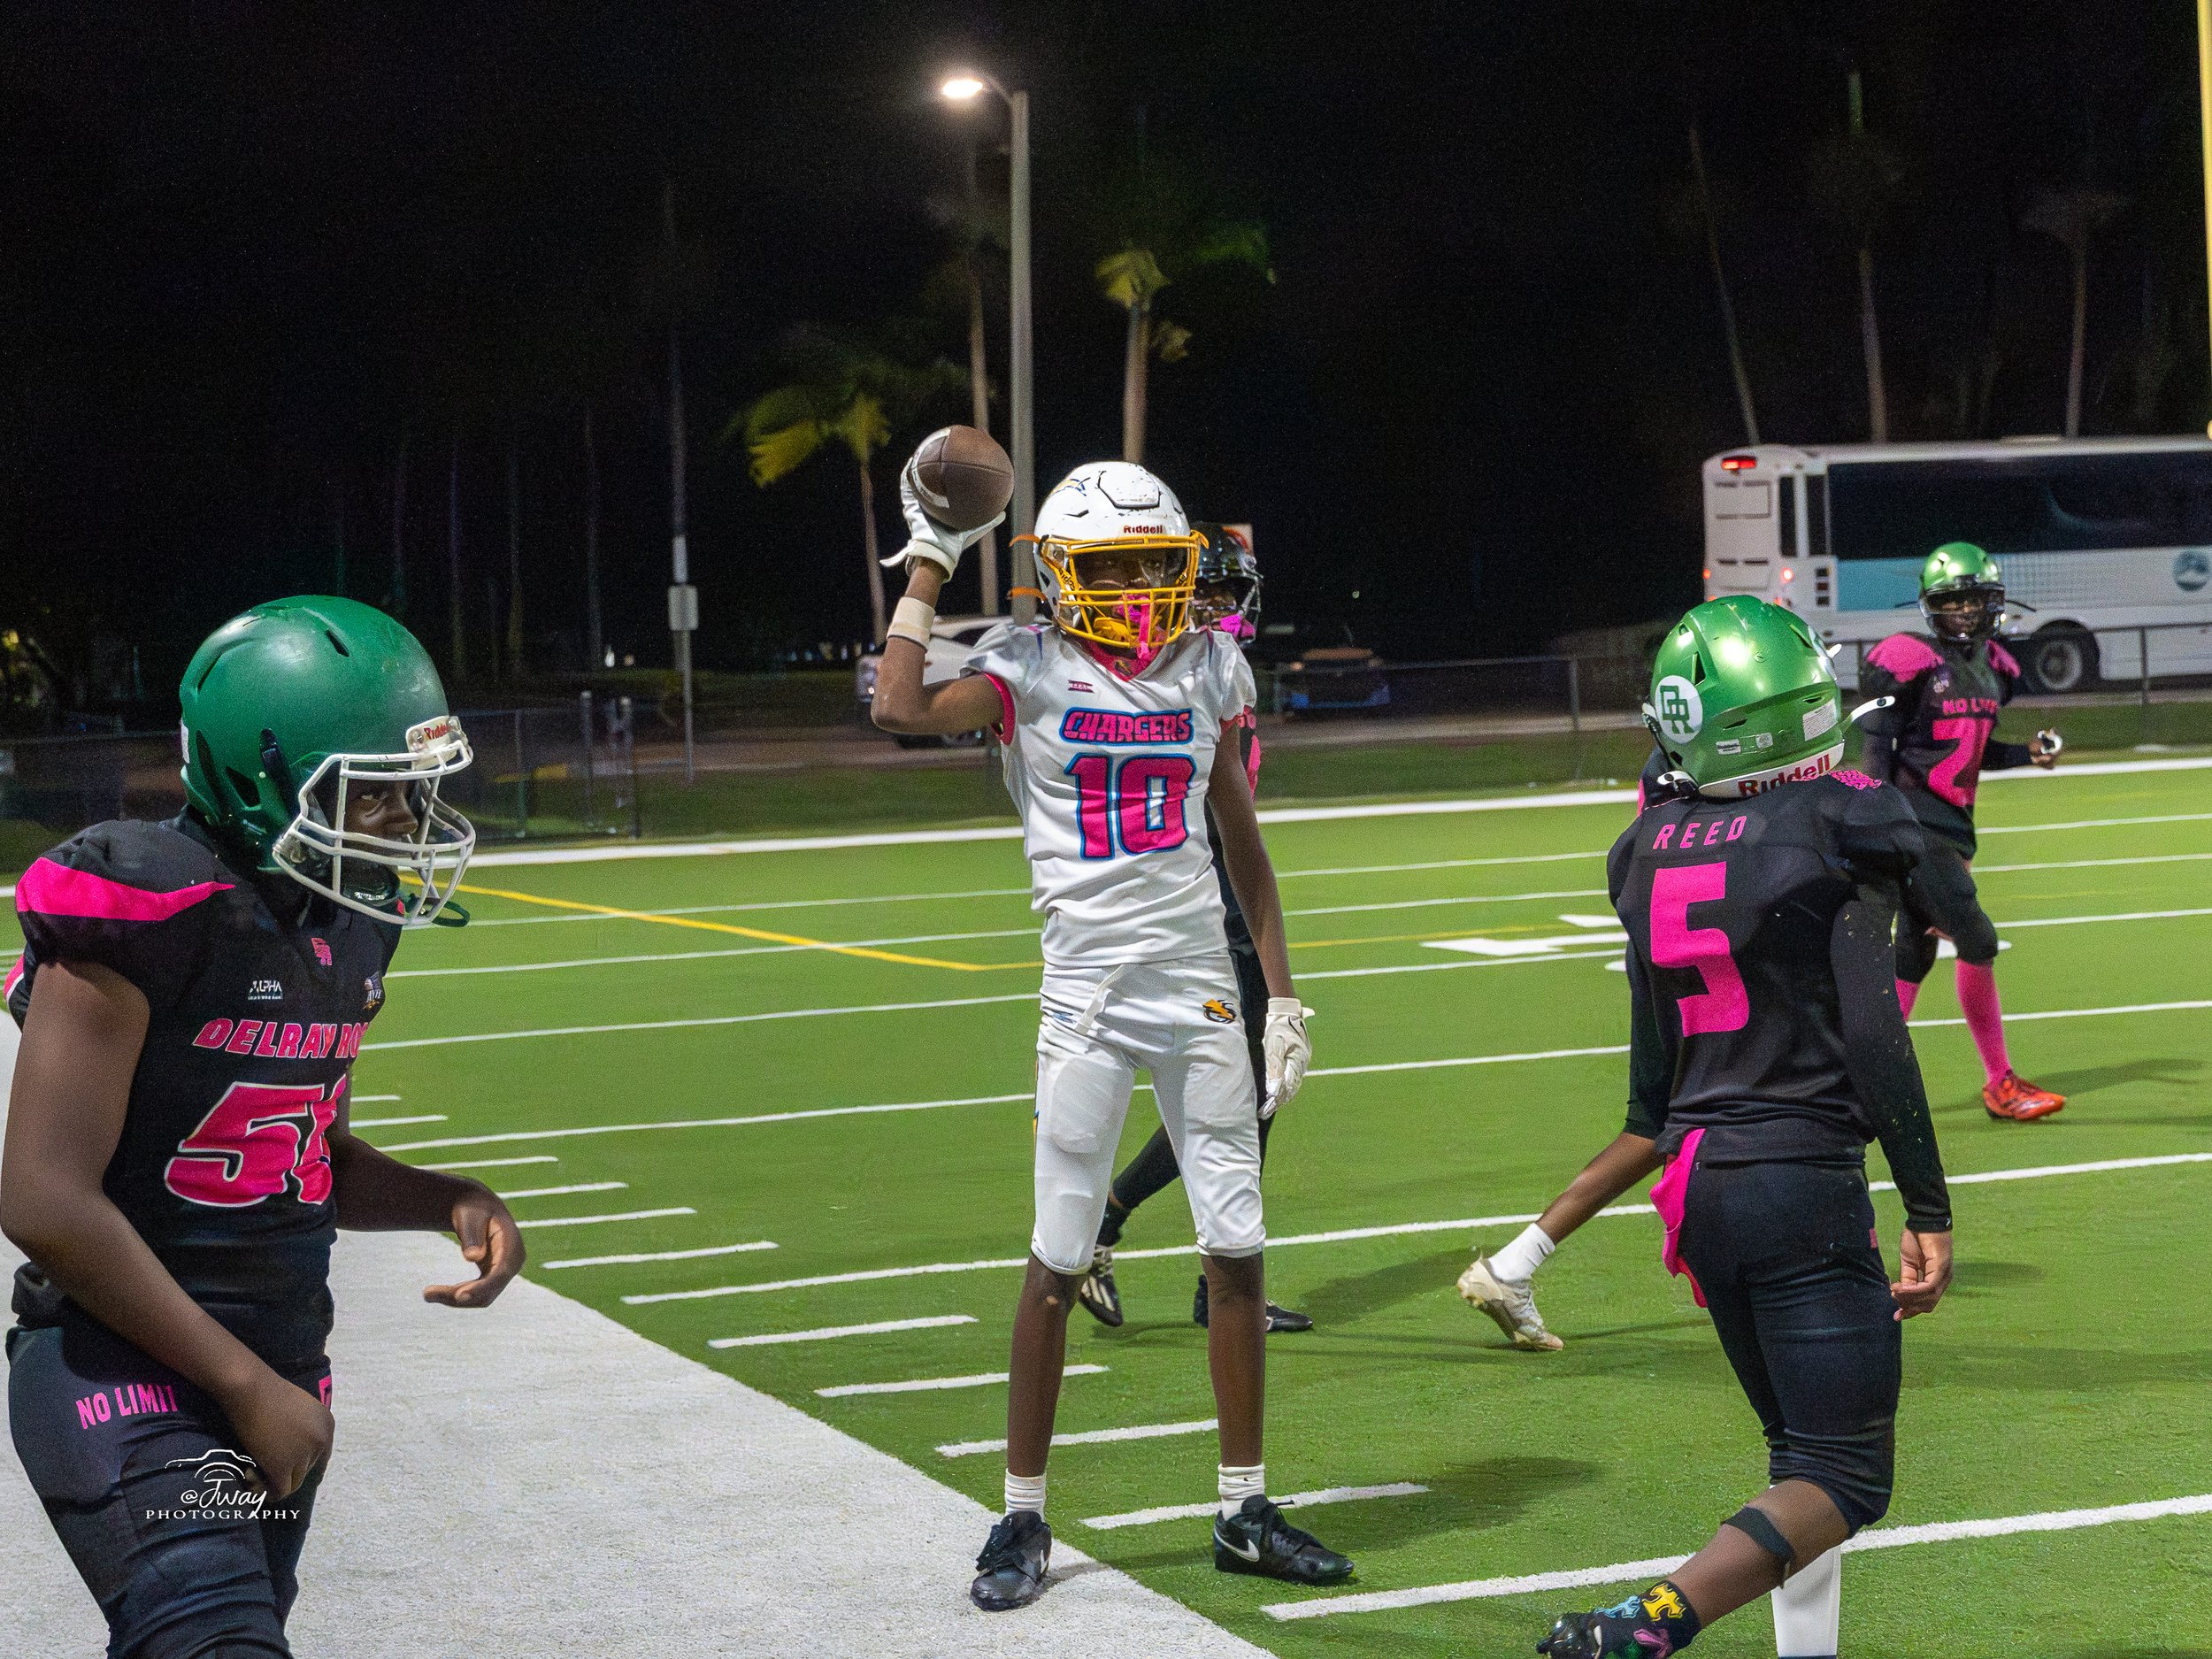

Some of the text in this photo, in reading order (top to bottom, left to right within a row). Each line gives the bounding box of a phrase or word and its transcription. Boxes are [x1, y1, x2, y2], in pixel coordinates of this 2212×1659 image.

[1123, 524, 1164, 534] Riddell
[1060, 708, 1194, 745] CHARGERS
[1064, 753, 1196, 860] 10
[1652, 816, 1747, 849] REED
[1649, 861, 1750, 1038] 5
[192, 1018, 338, 1060] DELRAY
[75, 1392, 111, 1430] NO
